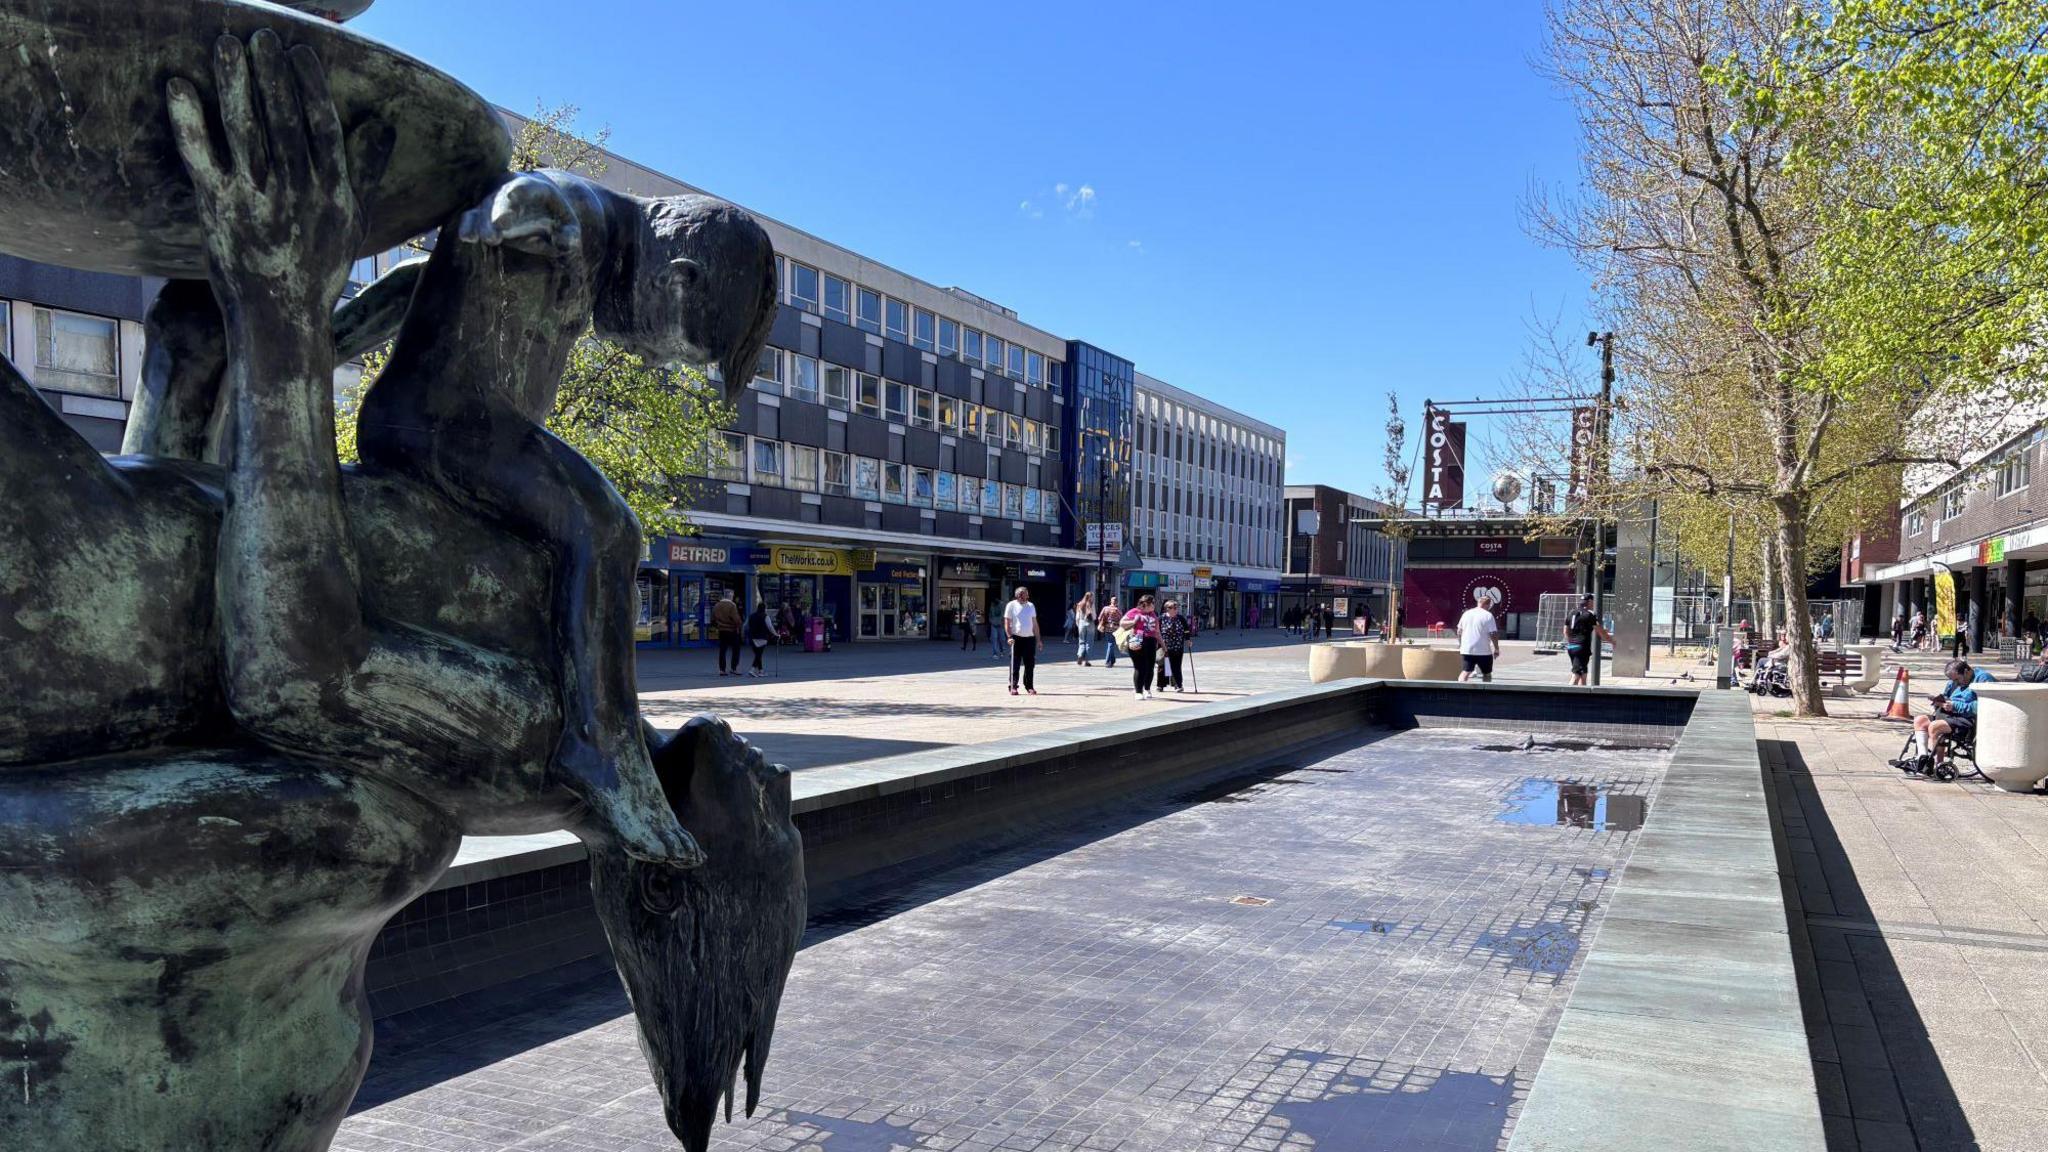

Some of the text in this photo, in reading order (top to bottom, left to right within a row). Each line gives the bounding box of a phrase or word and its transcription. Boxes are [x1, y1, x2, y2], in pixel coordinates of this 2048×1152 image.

[1428, 416, 1446, 498] COSTA
[671, 545, 727, 563] BETFRED
[780, 553, 835, 567] TheWorks.co.uk
